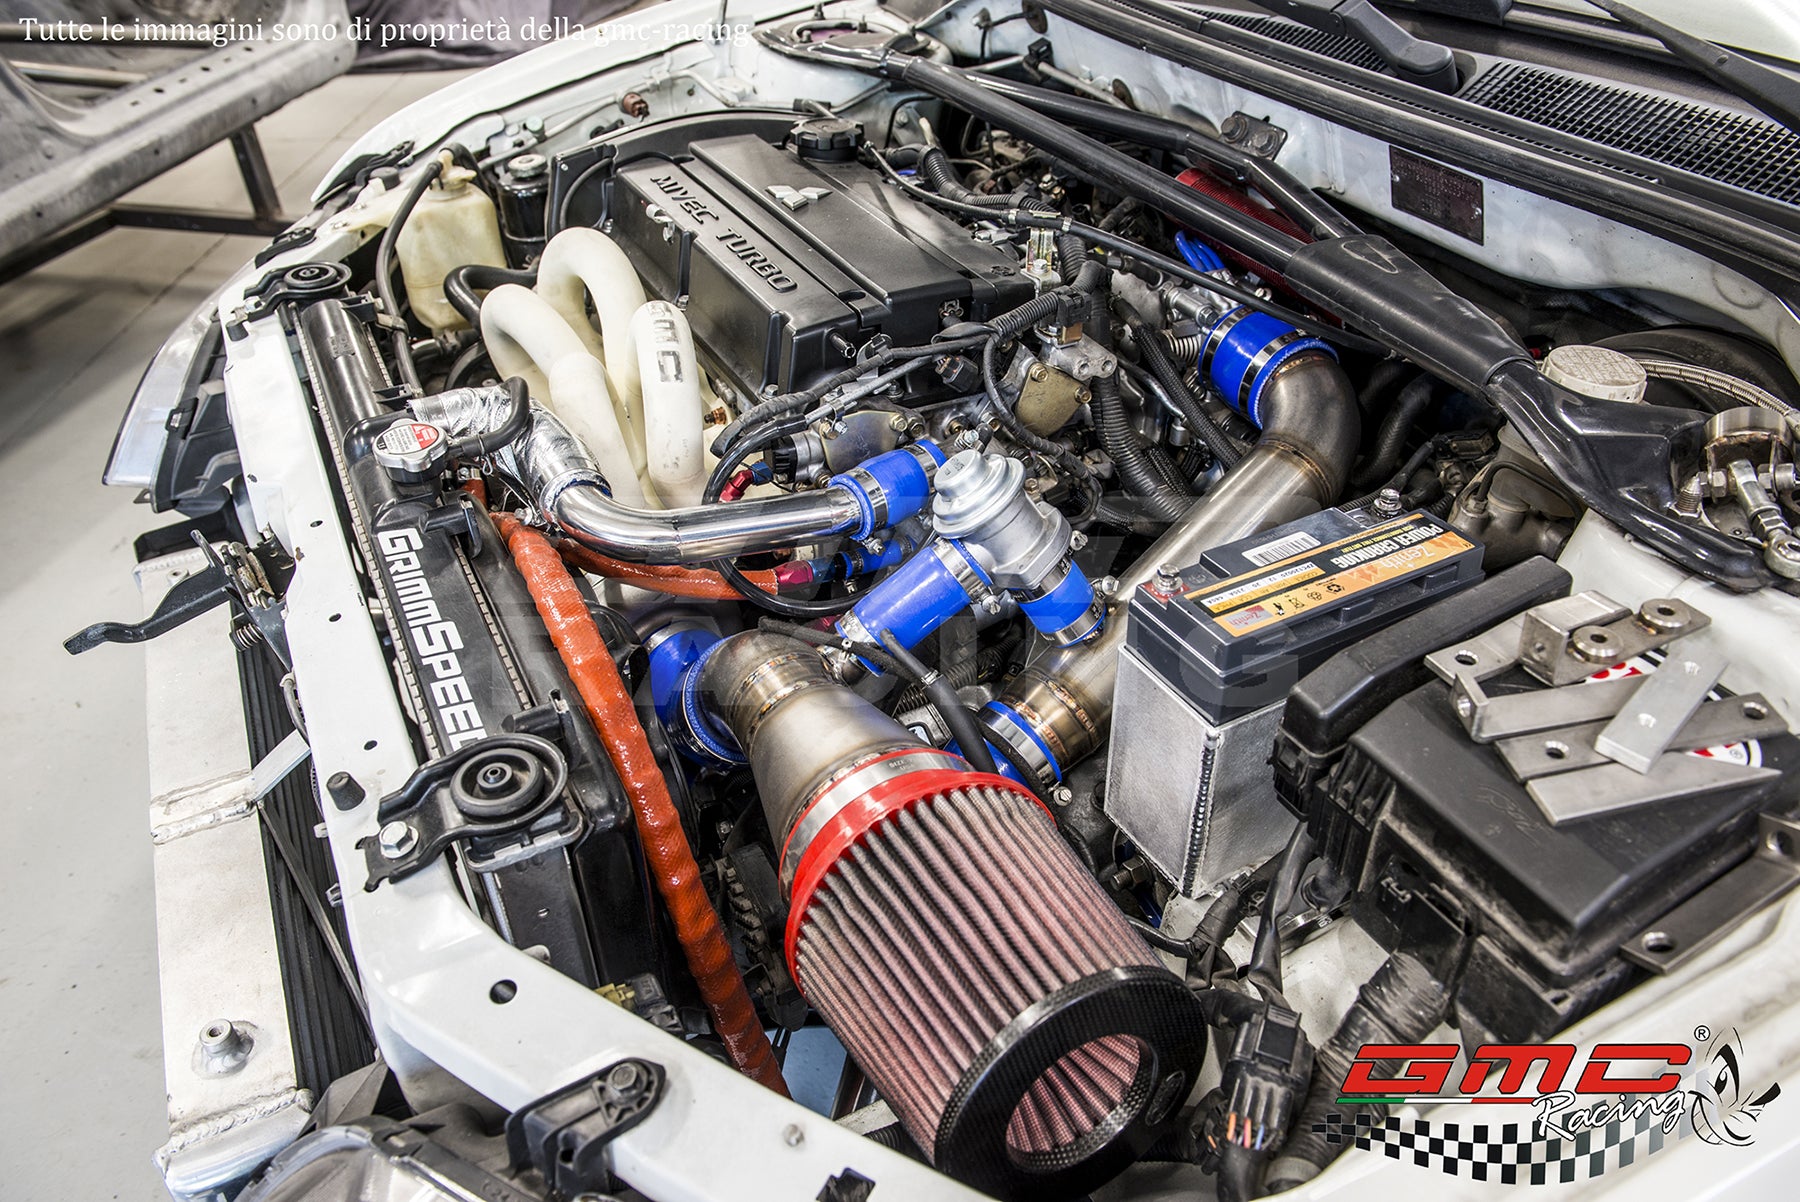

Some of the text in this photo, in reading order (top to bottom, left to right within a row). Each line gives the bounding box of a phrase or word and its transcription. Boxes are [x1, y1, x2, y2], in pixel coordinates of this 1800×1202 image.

[650, 174, 798, 294] MIVEC TURBO
[1391, 523, 1445, 546] POWER
[1329, 538, 1401, 569] CRANKING
[1376, 544, 1436, 571] Zenith
[1226, 610, 1263, 628] Zenith
